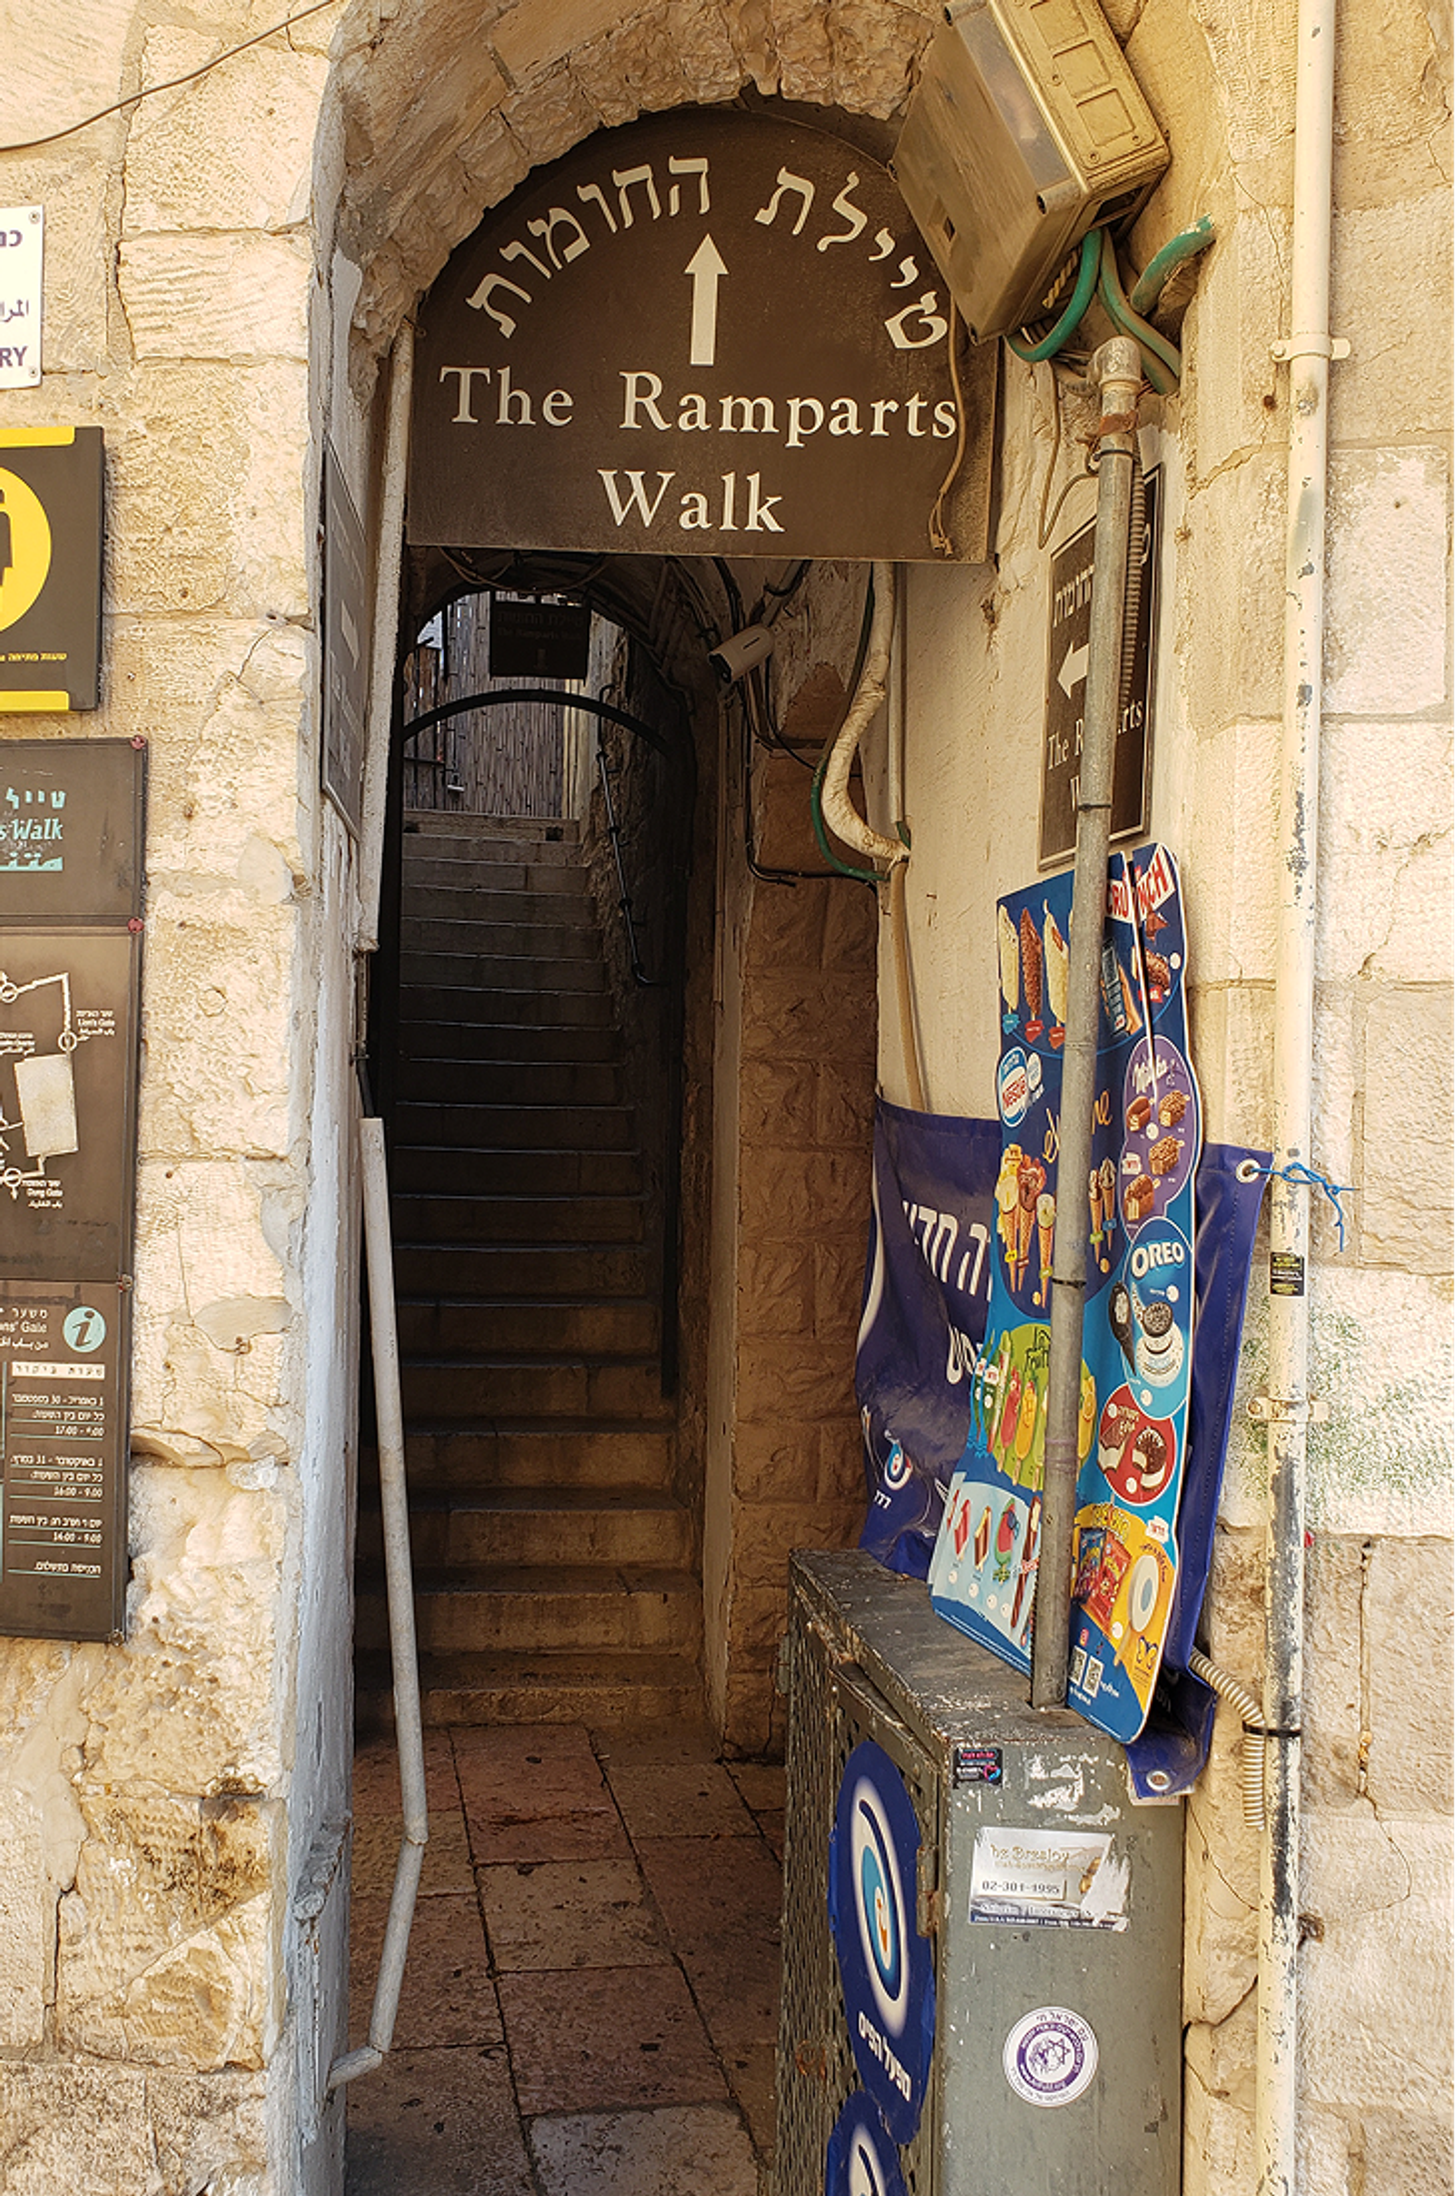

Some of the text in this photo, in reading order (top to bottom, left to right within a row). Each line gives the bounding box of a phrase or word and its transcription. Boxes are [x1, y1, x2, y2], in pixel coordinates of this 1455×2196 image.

[465, 155, 949, 350] טיילת החומות
[439, 365, 958, 448] The Ramparts
[597, 467, 785, 533] Walk
[1047, 732, 1069, 771] The
[11, 818, 64, 840] Walk
[1131, 1241, 1185, 1278] OREO
[858, 2010, 912, 2102] מפעל הפיס
